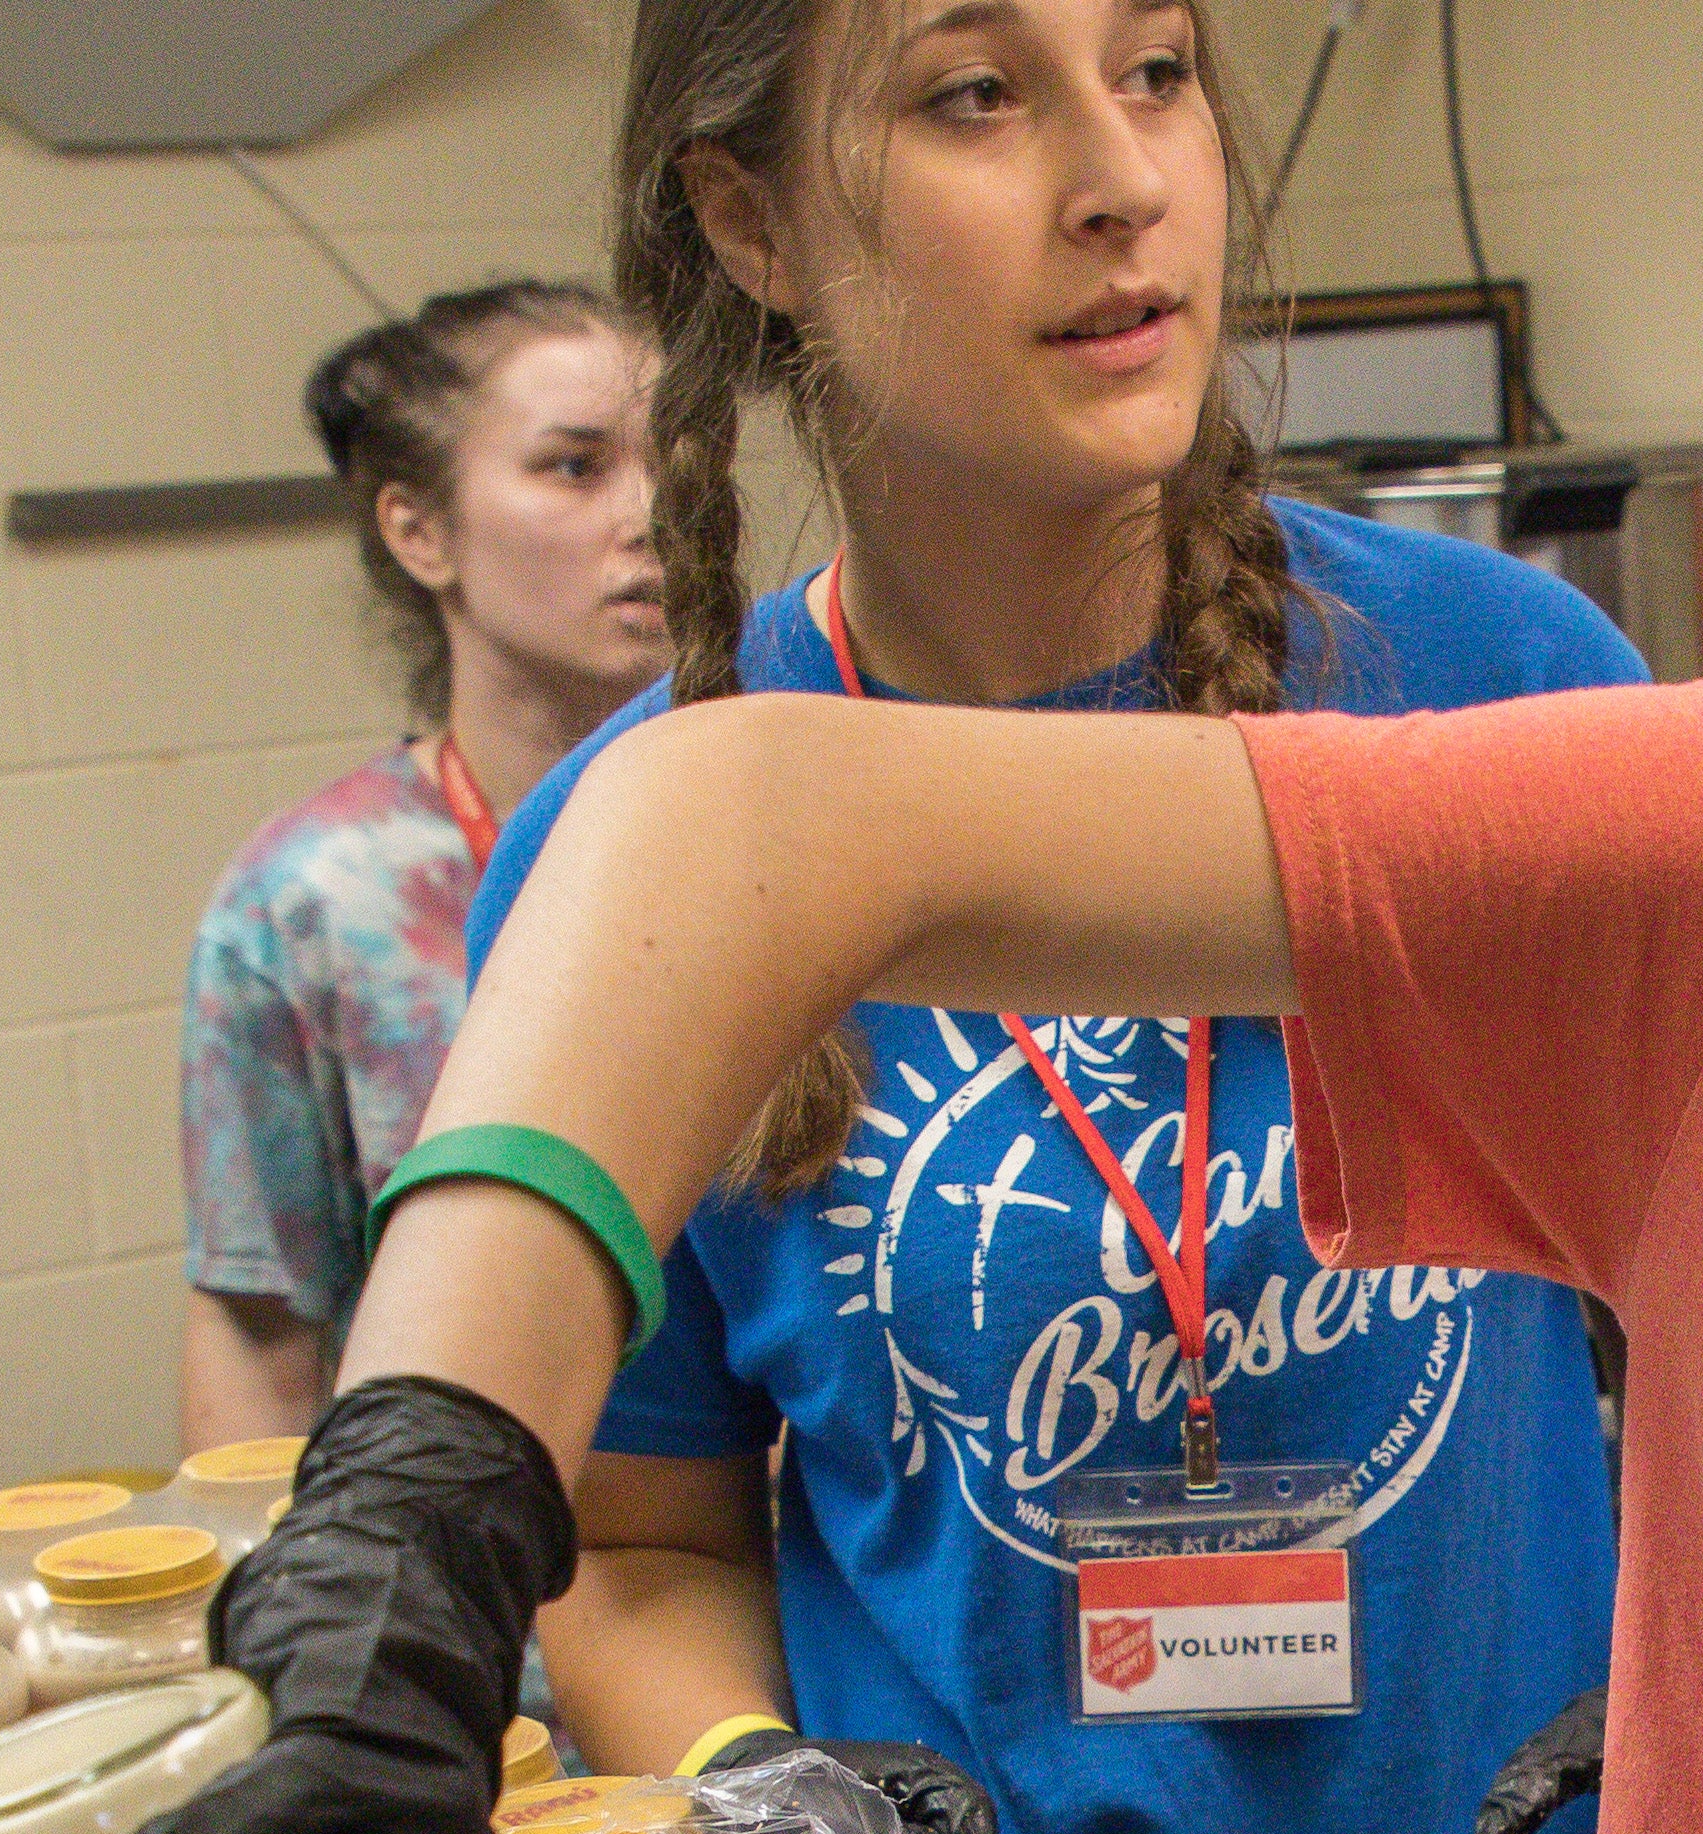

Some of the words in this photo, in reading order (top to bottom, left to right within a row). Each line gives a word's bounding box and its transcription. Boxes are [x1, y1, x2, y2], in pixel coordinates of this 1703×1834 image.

[1014, 1497, 1060, 1538] WHAT
[1370, 1413, 1418, 1469] STAY
[1408, 1381, 1436, 1417] AT
[1425, 1311, 1456, 1381] CAMP
[1159, 1633, 1338, 1660] VOLUNTEER
